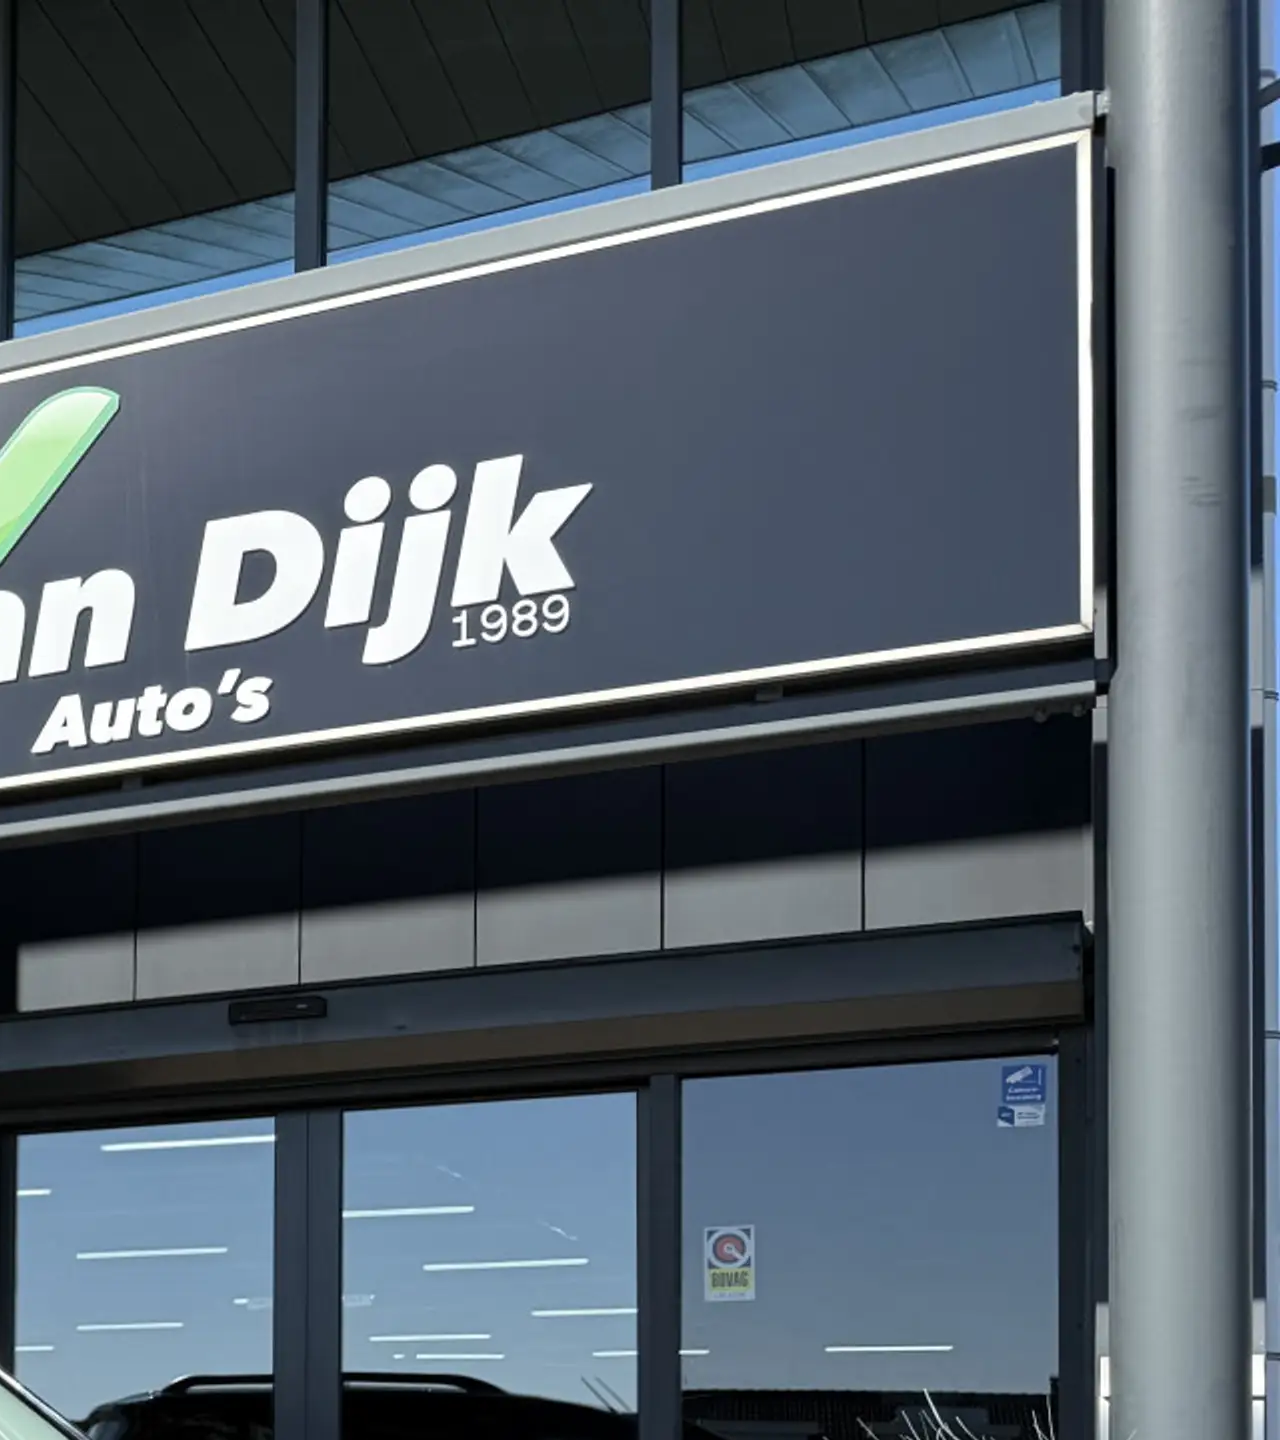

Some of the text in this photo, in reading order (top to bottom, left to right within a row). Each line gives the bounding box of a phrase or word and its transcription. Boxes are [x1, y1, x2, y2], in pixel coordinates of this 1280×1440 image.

[184, 454, 594, 665] Dijk
[450, 594, 571, 649] 1989
[31, 668, 273, 755] Auto's
